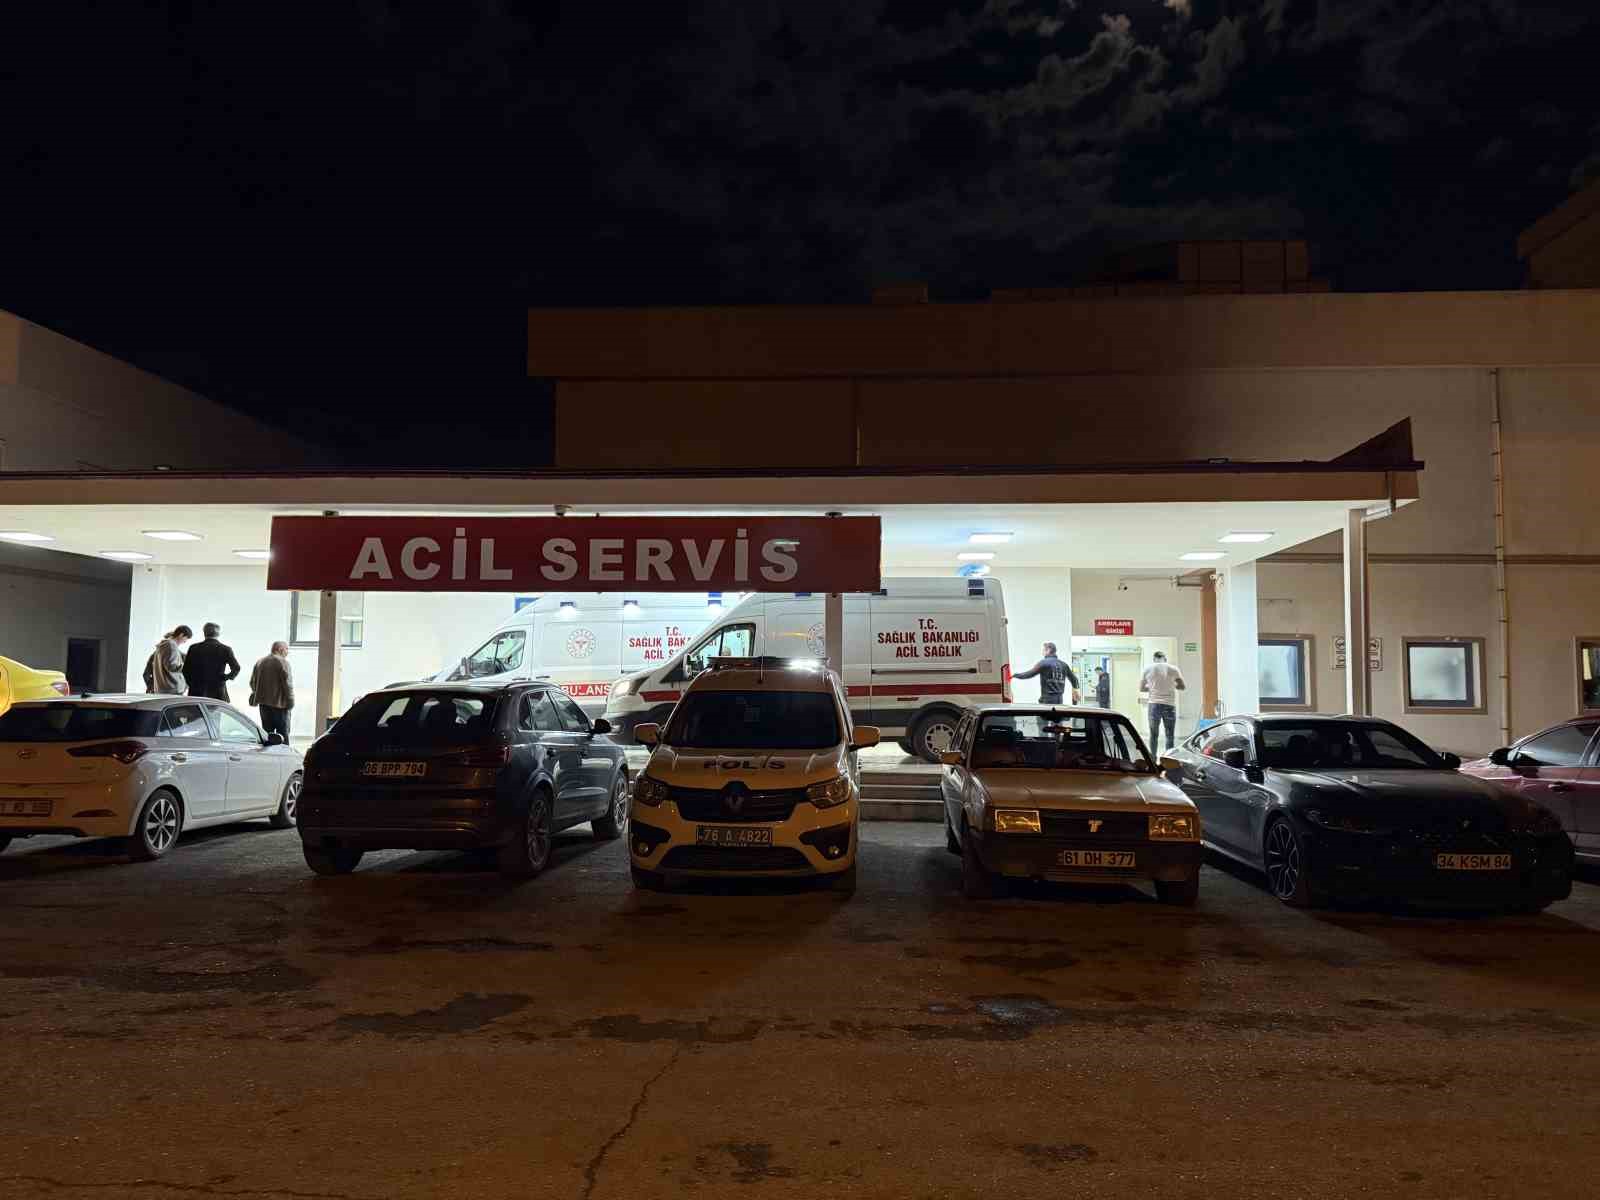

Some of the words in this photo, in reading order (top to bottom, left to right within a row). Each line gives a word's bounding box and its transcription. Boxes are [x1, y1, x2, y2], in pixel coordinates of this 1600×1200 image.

[349, 527, 513, 581] ACİL
[540, 528, 800, 582] SERVİS
[918, 618, 938, 630] T.C.
[665, 626, 681, 637] T.C.
[877, 630, 916, 644] SAĞLIK
[922, 629, 979, 643] BAKANLIĞI
[644, 648, 664, 660] ACİL
[895, 645, 920, 658] ACİL
[924, 644, 962, 657] SAĞLIK
[704, 829, 719, 841] 76
[1065, 852, 1078, 865] 61
[1084, 852, 1102, 865] DH
[1108, 853, 1133, 866] 377
[1439, 855, 1455, 868] 34
[1460, 855, 1490, 868] KSM
